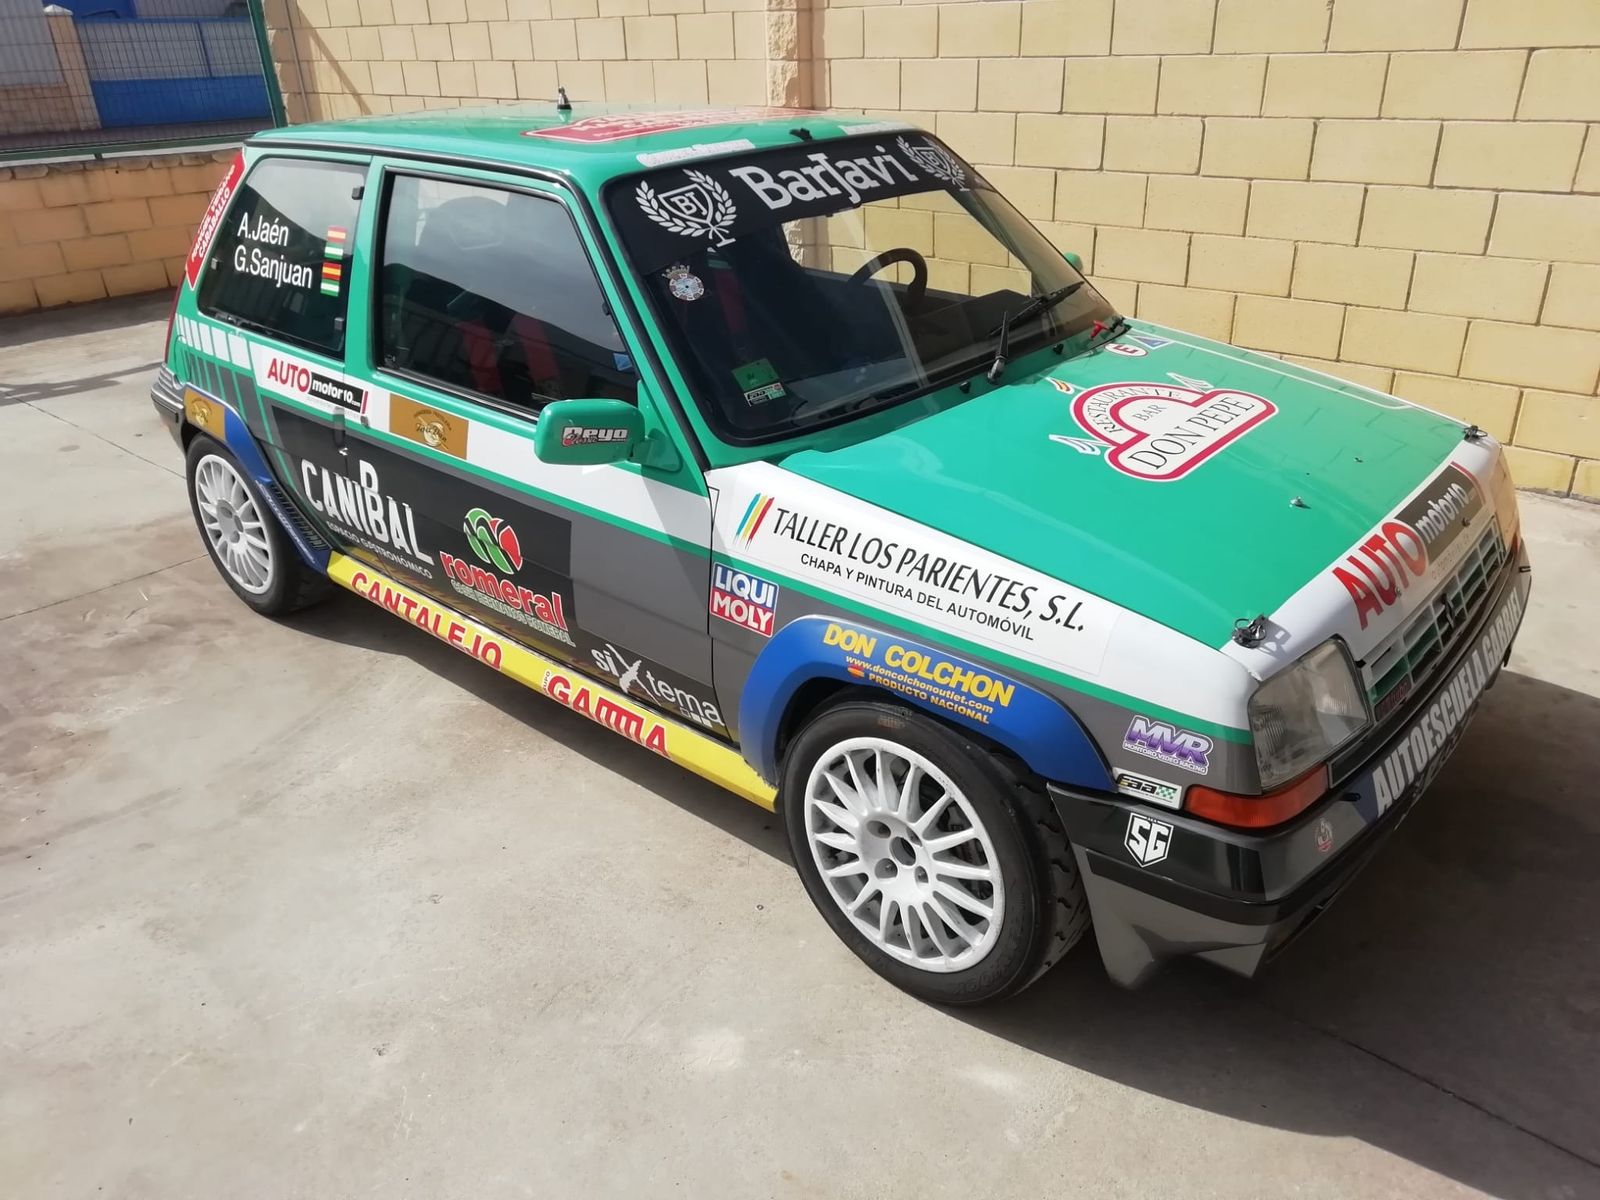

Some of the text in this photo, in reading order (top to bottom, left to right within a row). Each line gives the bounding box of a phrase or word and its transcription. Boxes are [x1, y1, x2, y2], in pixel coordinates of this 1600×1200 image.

[237, 212, 289, 247] A.Jaén
[234, 244, 313, 289] G.Sanjuan
[267, 358, 310, 392] AUTO
[1127, 396, 1256, 470] DON PEPE
[1132, 404, 1168, 422] BAR
[439, 551, 569, 632] romeral
[715, 566, 775, 608] LIQUI
[773, 508, 1085, 632] TALLER LOS PARIENTES, S.L.
[1332, 522, 1427, 632] AUTO
[713, 591, 773, 632] MOLY
[801, 553, 1034, 641] CHAPA Y PINTURA DEL AUTOMÓVIL
[823, 623, 1015, 707] DON COLCHON
[846, 655, 993, 714] www.doncolchonoutlet.com
[868, 673, 928, 700] PRODUCTO
[929, 694, 990, 725] NACIONAL
[1127, 718, 1209, 765] MVR
[1372, 649, 1487, 818] AUTOESCUELA
[1179, 760, 1206, 774] RACING
[1129, 816, 1170, 863] SG
